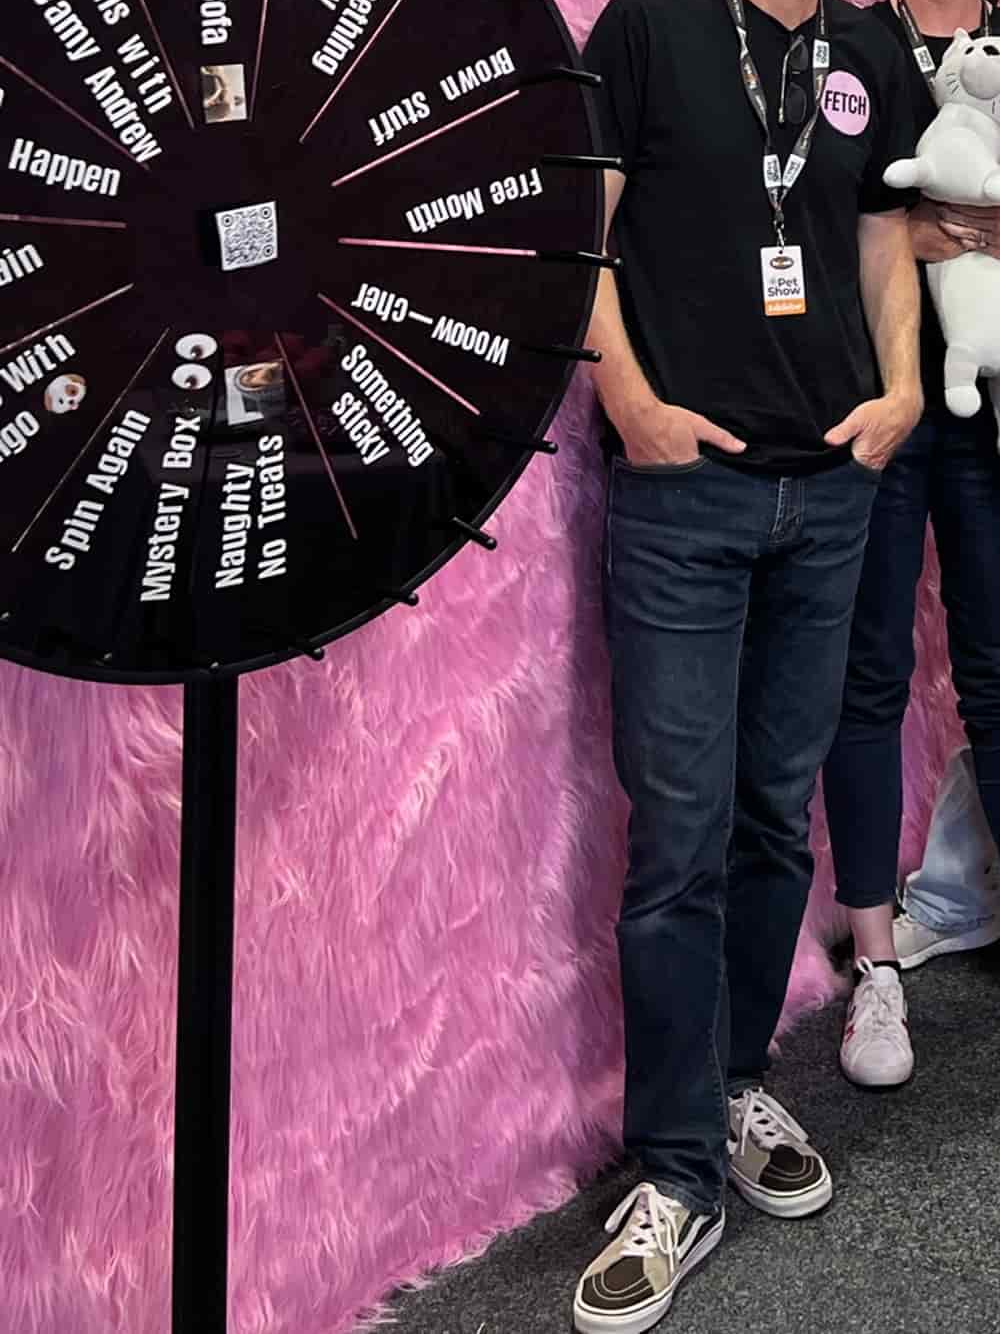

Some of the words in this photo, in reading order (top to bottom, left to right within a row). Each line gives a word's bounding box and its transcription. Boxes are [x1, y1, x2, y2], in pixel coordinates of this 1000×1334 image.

[117, 33, 173, 114] with
[439, 46, 516, 101] Brown
[824, 90, 867, 117] FETCH
[84, 65, 163, 163] Andrew
[368, 91, 431, 147] Stuff
[8, 137, 121, 197] Happen
[489, 167, 543, 205] Free
[405, 187, 485, 233] Month
[767, 285, 801, 298] Show
[777, 276, 799, 287] Pet
[0, 333, 76, 393] With
[331, 391, 390, 465] sticky
[341, 344, 434, 467] Something
[162, 407, 201, 469] Box
[45, 500, 105, 571] Spin
[85, 409, 151, 494] Again
[255, 434, 286, 529] Treats
[140, 482, 190, 602] Mystery
[215, 463, 255, 589] Naughty
[257, 538, 287, 579] No
